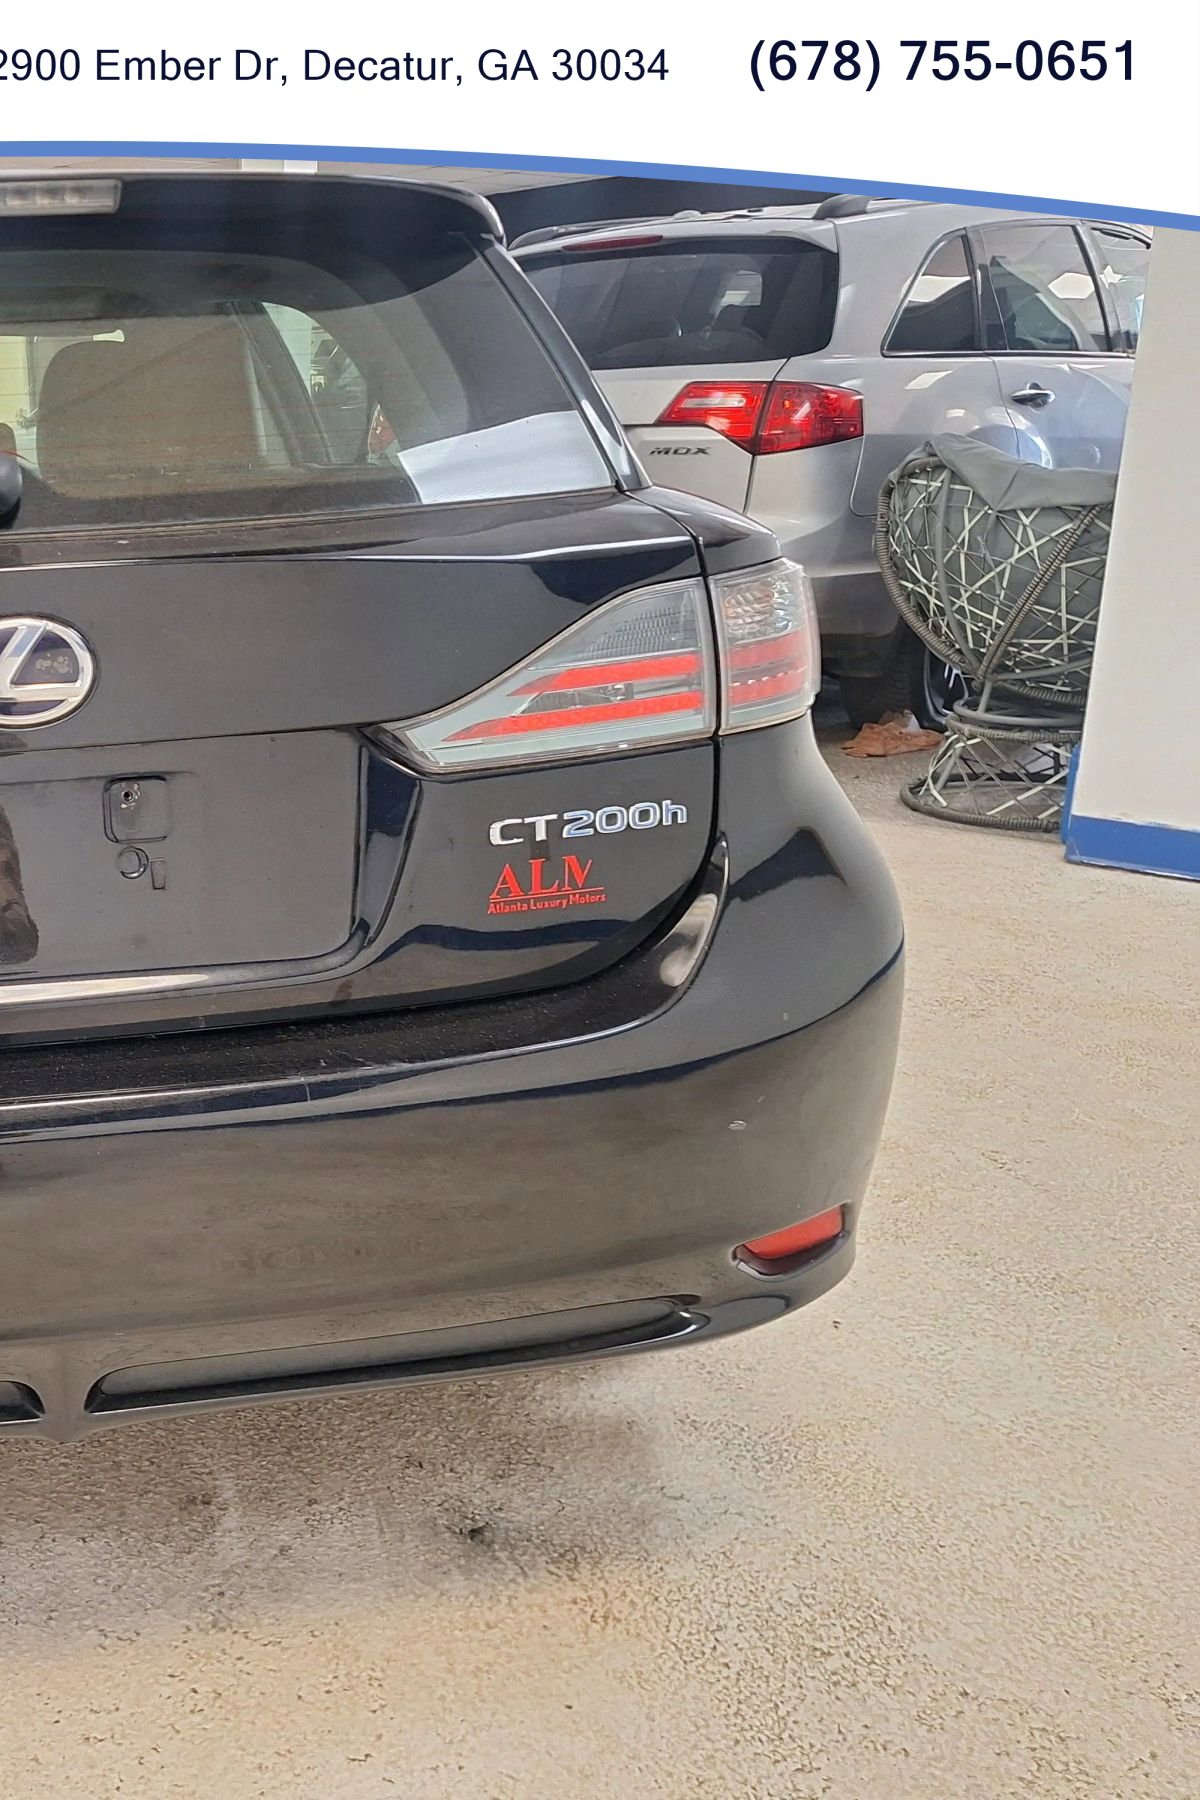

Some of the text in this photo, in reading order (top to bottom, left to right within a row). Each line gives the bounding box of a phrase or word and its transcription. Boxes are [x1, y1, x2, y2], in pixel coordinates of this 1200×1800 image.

[487, 892, 607, 915] Atlanta Luxury Motors
